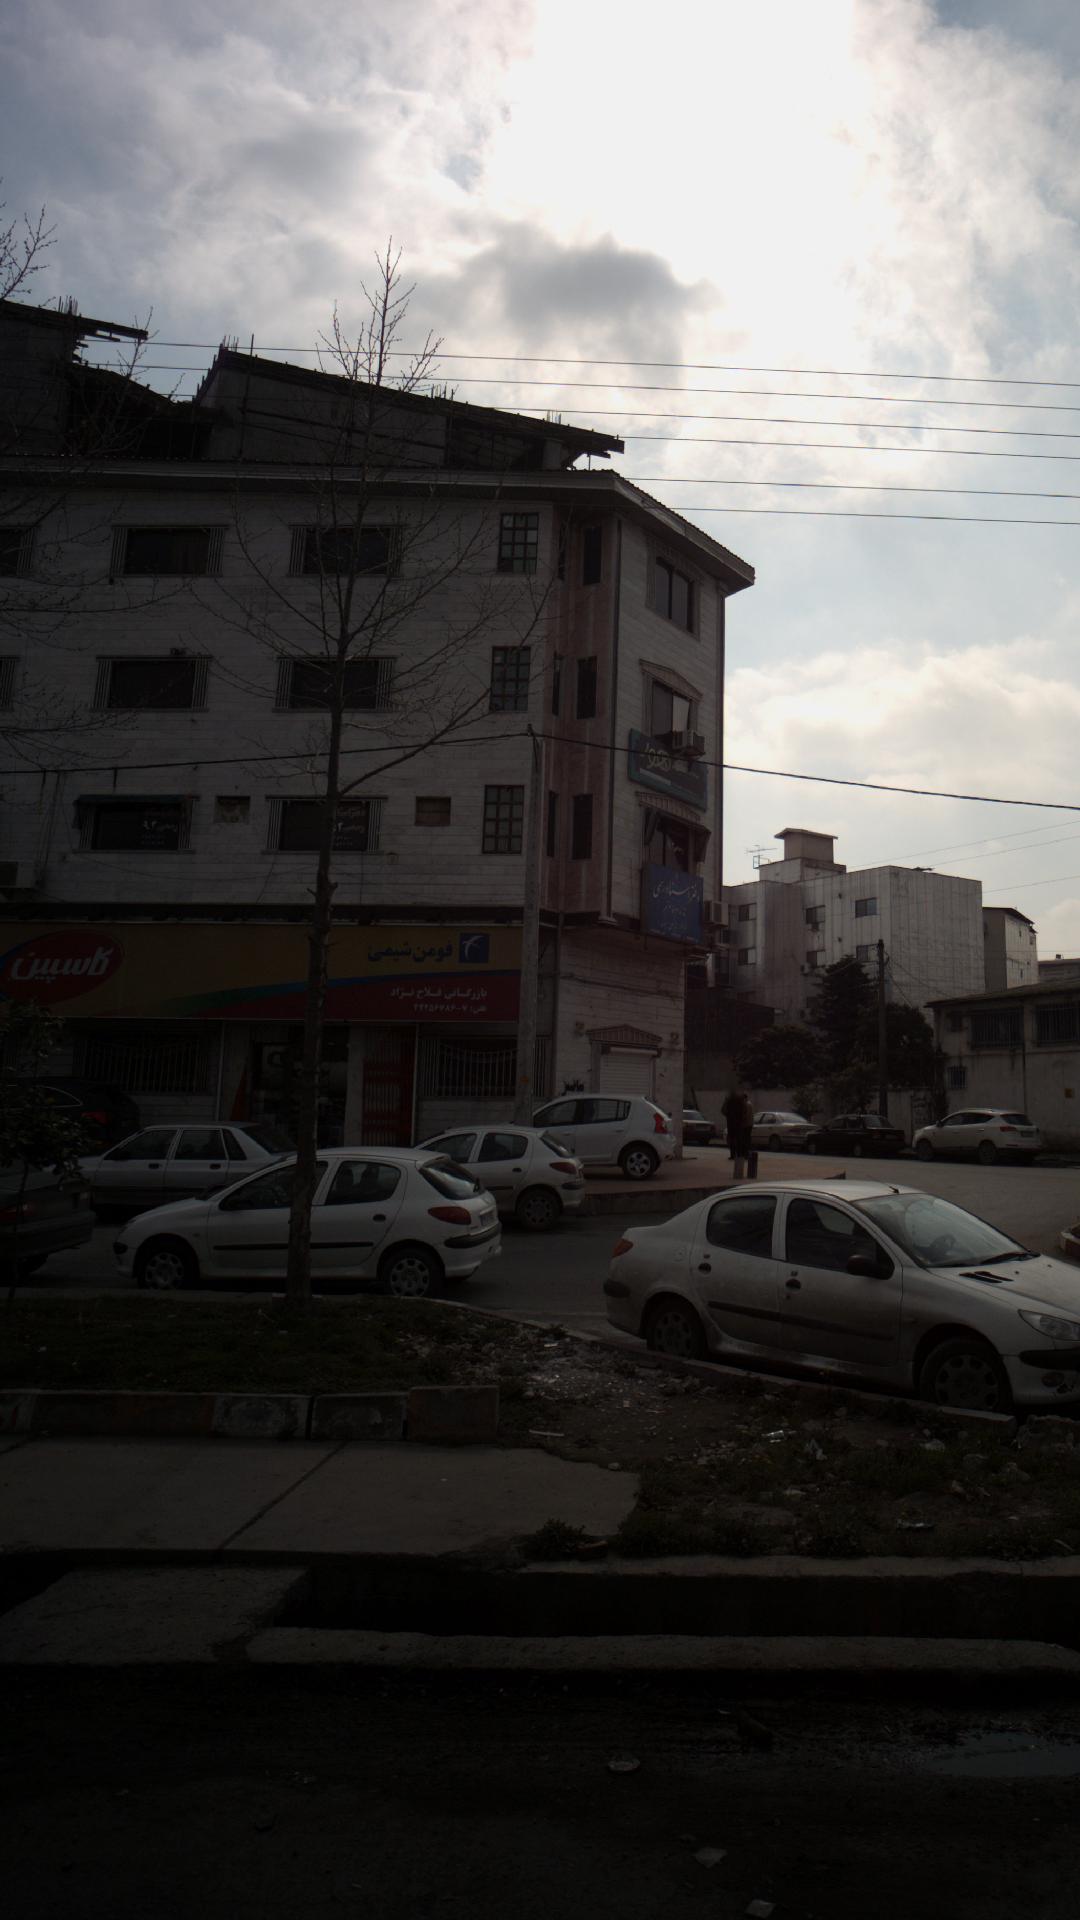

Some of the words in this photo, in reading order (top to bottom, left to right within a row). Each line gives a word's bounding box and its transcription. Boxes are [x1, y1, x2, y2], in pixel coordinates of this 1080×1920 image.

[367, 940, 412, 962] شیمی
[412, 941, 453, 962] فومن
[9, 945, 115, 984] کاسپین
[444, 985, 488, 1001] بازرگانی
